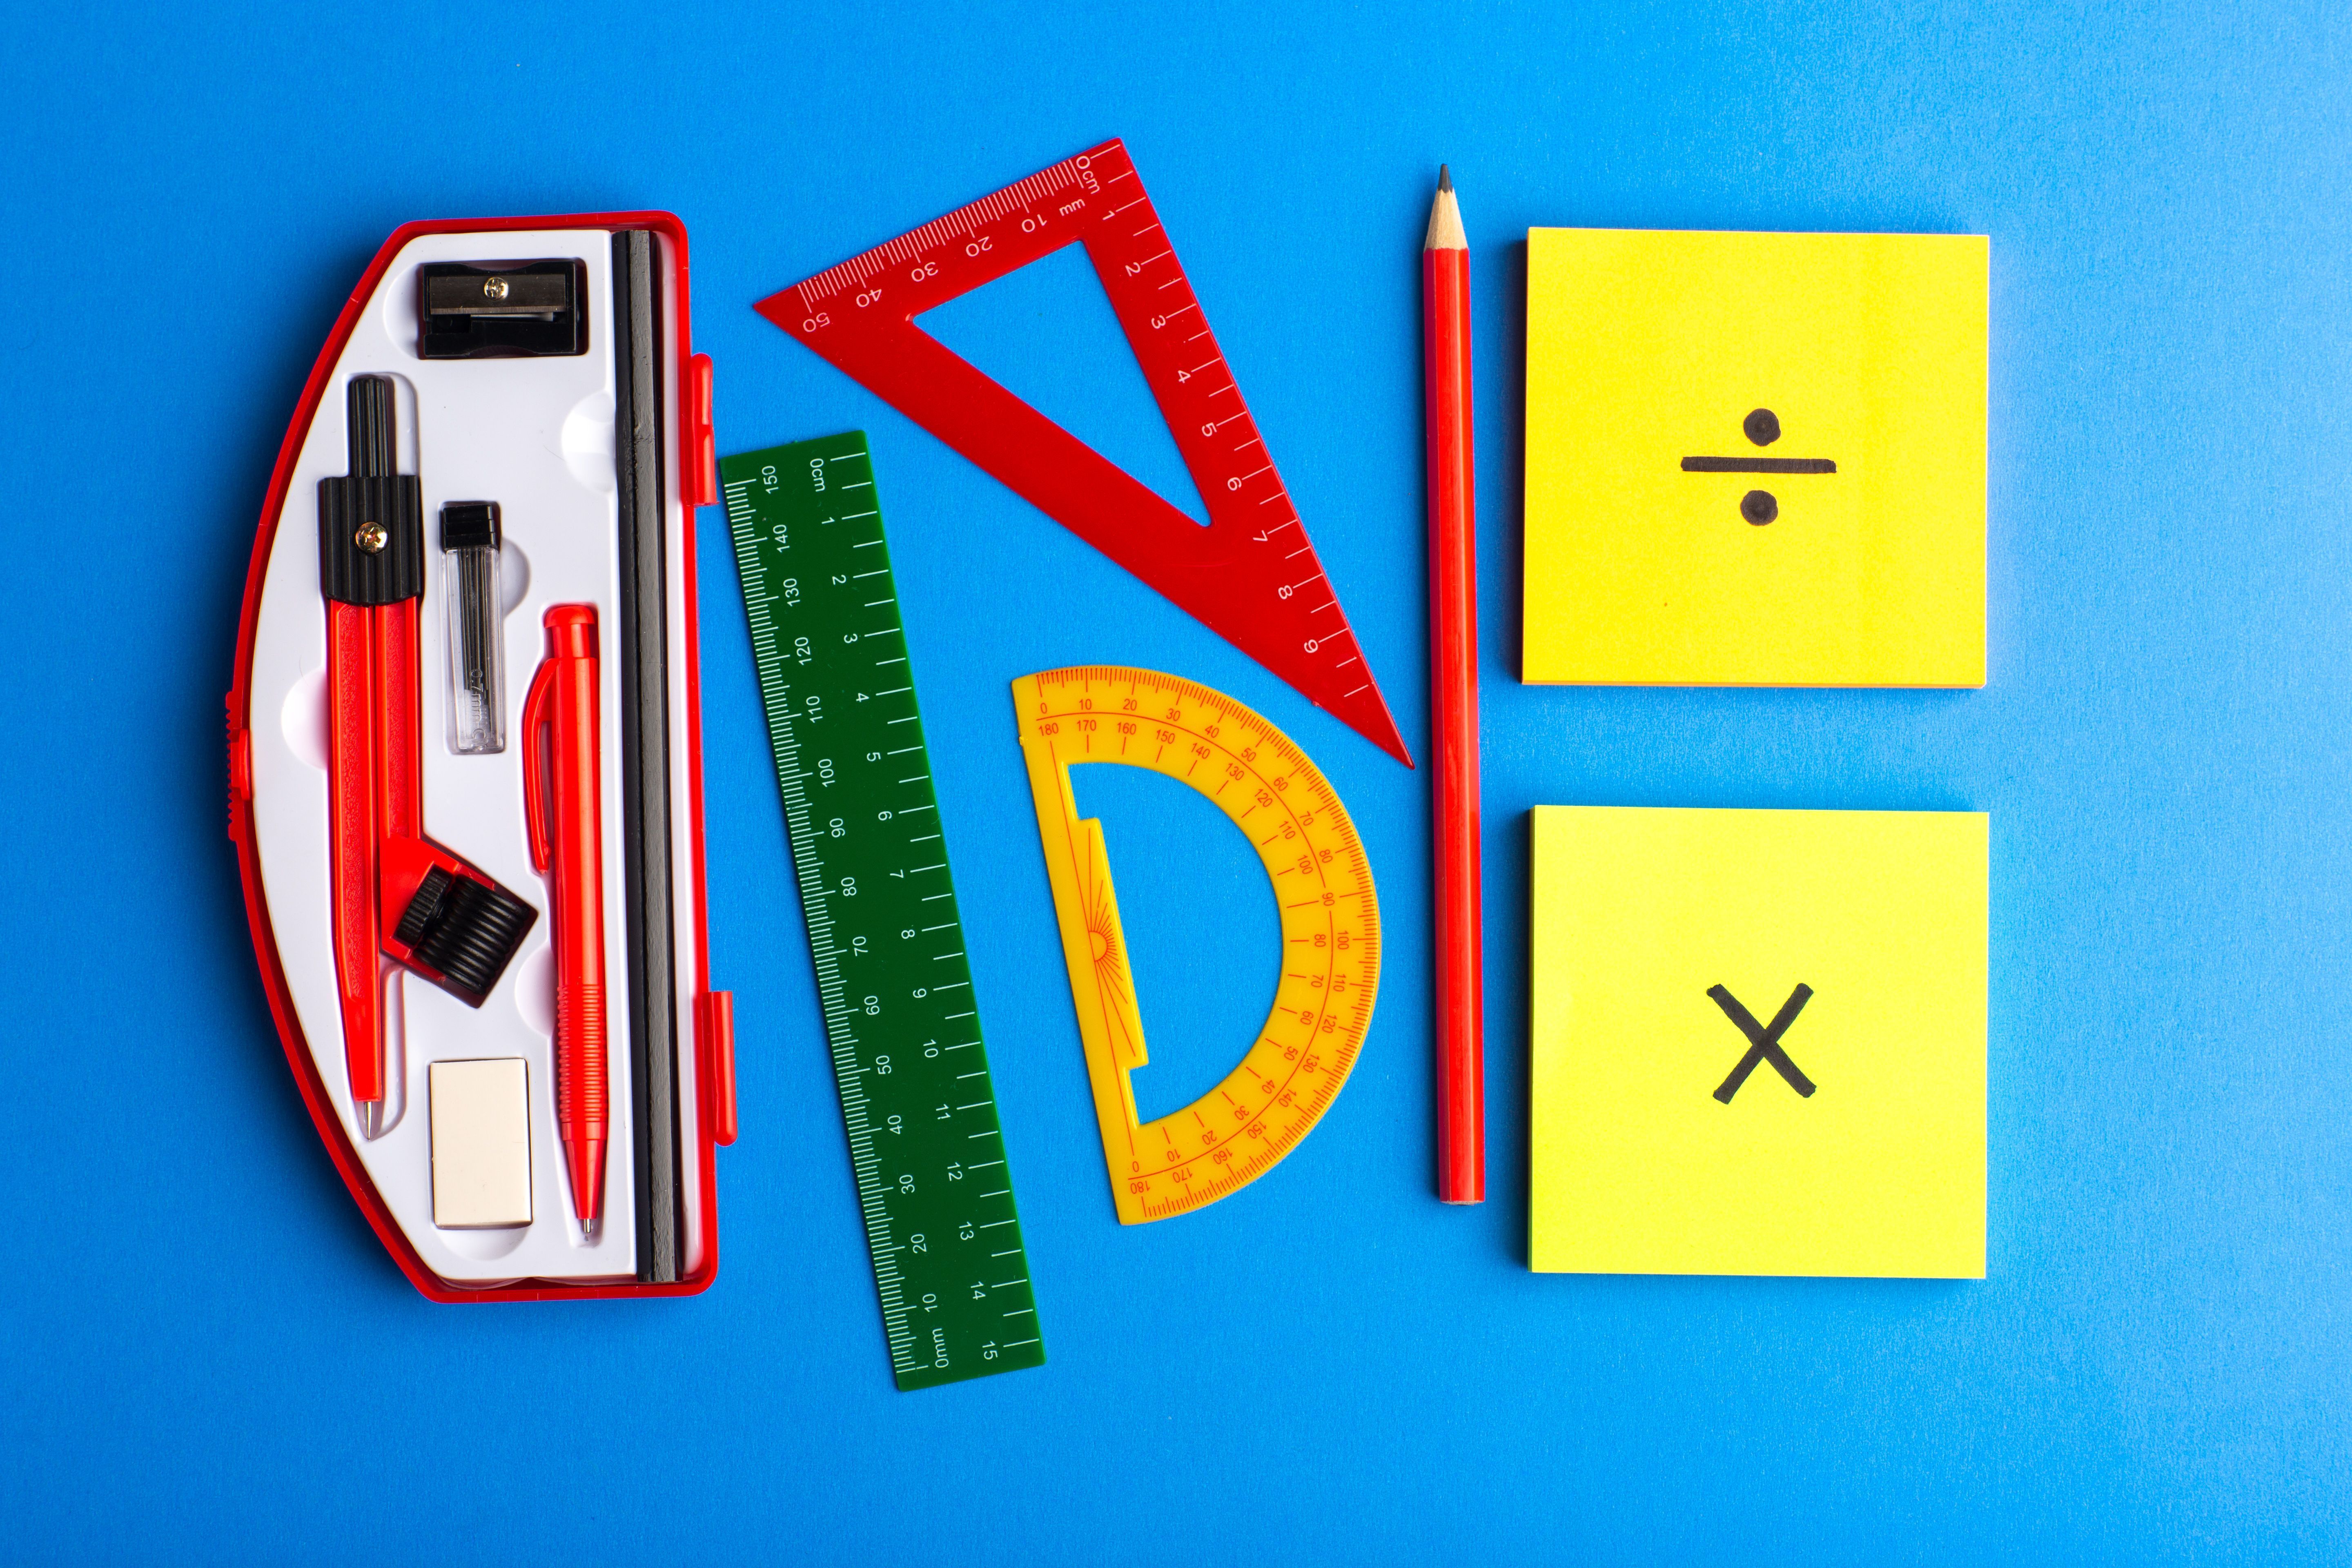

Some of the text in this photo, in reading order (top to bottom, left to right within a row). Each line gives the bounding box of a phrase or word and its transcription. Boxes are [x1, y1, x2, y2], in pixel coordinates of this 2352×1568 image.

[802, 198, 1086, 333] 50 40 30 20 10 mm
[1102, 210, 1116, 220] 1
[1125, 261, 1141, 277] 2
[1151, 314, 1166, 330] 3
[1177, 370, 1192, 384] 4
[1201, 422, 1218, 437] 5
[1227, 476, 1242, 491] 6
[1252, 529, 1269, 542] 7
[1277, 584, 1293, 600] 8
[1303, 639, 1319, 654] 9
[761, 465, 949, 1369] 0mm 10 20 30 40 50 60 70 80 90 100 110 120 130 140 150
[809, 458, 998, 1361] 0cm 1 2 3 4 5 6 7 8 9 10 11 12 13 14 15
[1038, 719, 1327, 1173] 180 170 160 150 140 130 120 110 100 80 70 60 50 40 30 20 10 0
[1040, 698, 1350, 1195] 0 10 20 30 40 50 60 70 80 90 100 110 120 130 140 150 160 170 180
